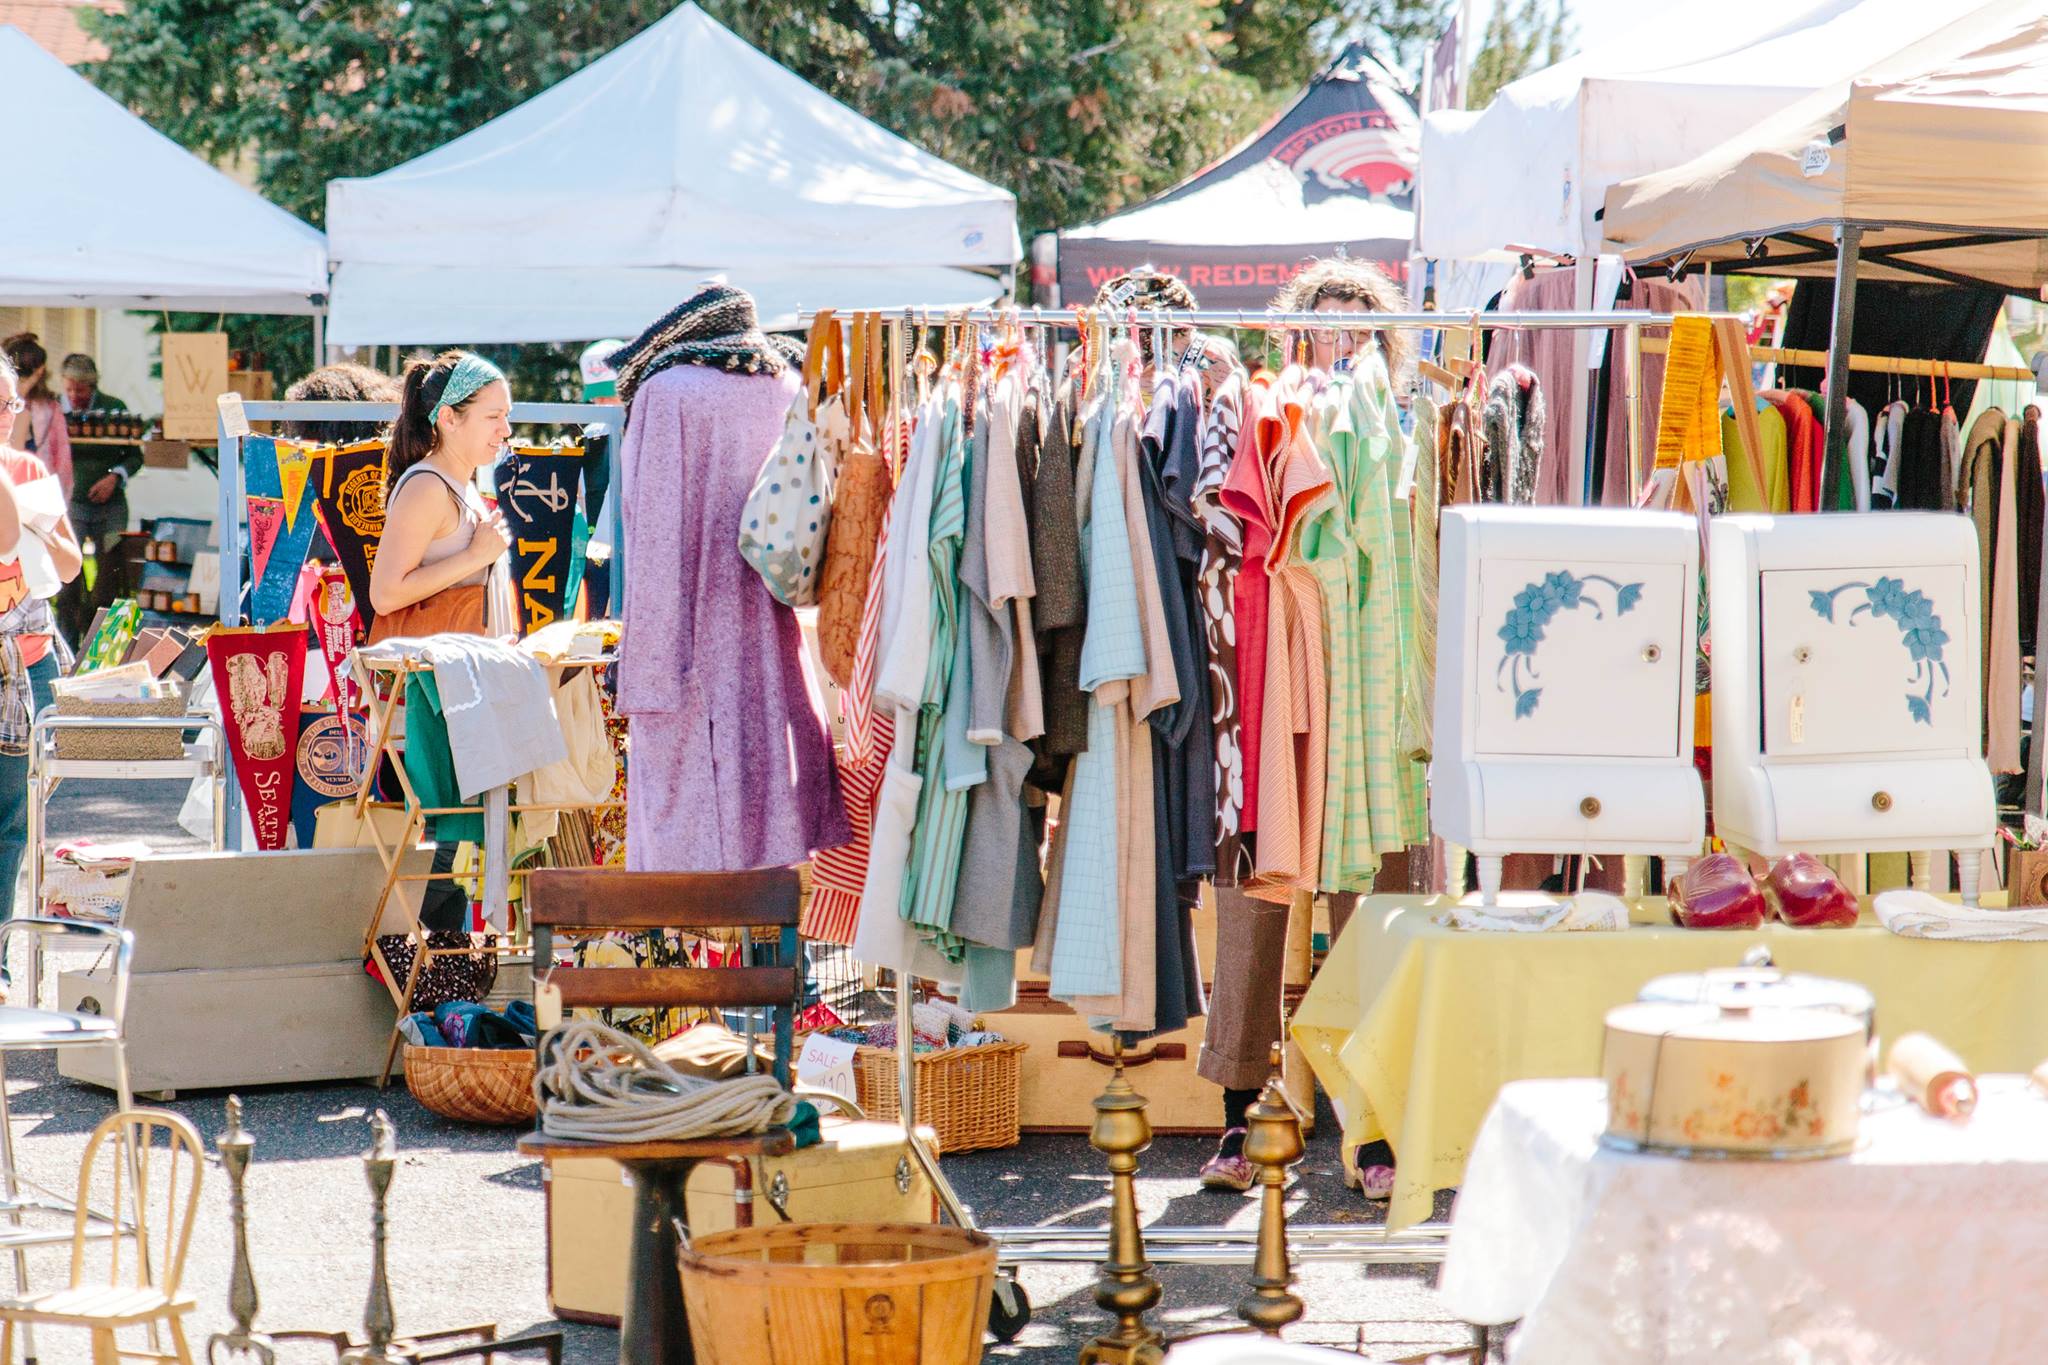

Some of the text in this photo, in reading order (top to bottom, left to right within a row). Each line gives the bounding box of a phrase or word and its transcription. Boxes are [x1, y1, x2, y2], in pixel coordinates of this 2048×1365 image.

[344, 472, 369, 495] REGENTS
[348, 512, 382, 532] MINNESOTA
[253, 771, 281, 850] SEATTL
[256, 809, 265, 841] WASH.
